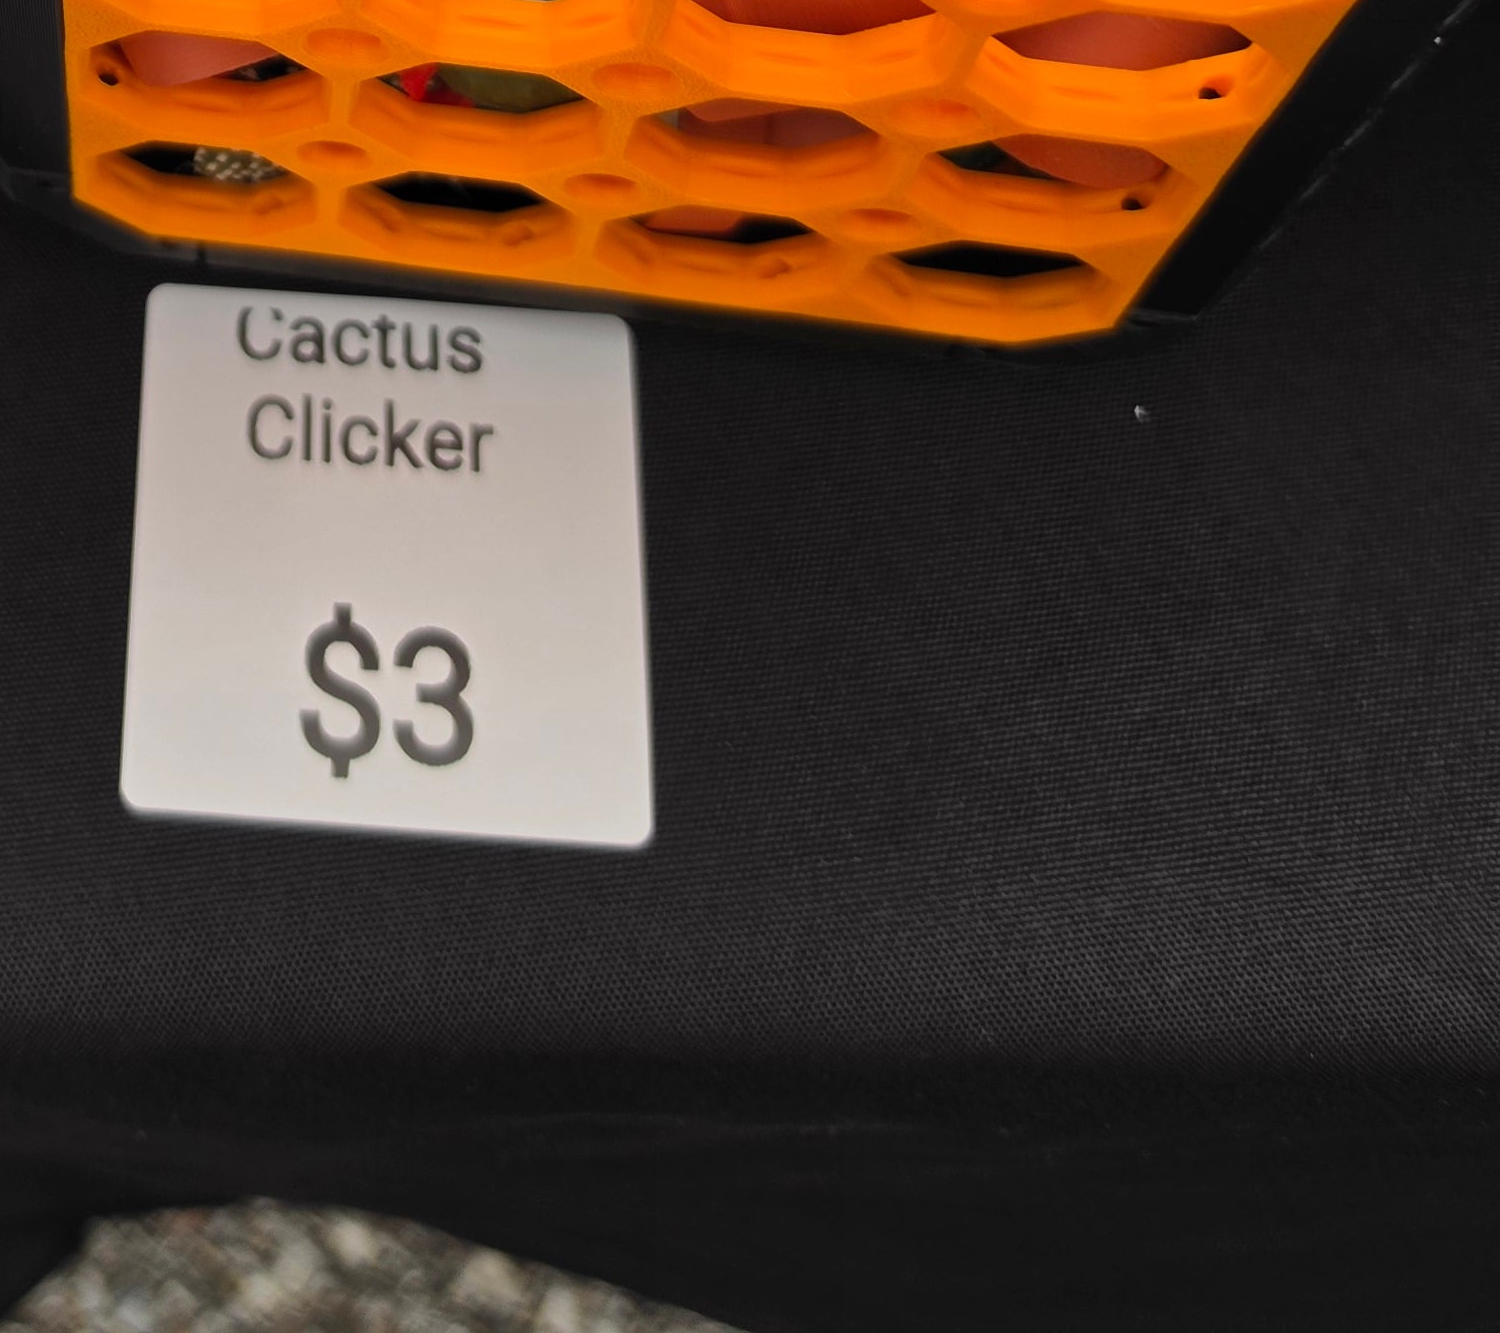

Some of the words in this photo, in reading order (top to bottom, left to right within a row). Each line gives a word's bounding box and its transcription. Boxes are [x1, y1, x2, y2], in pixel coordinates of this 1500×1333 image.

[237, 304, 484, 374] Cactus
[245, 393, 495, 473] Clicker
[299, 601, 475, 779] $3
